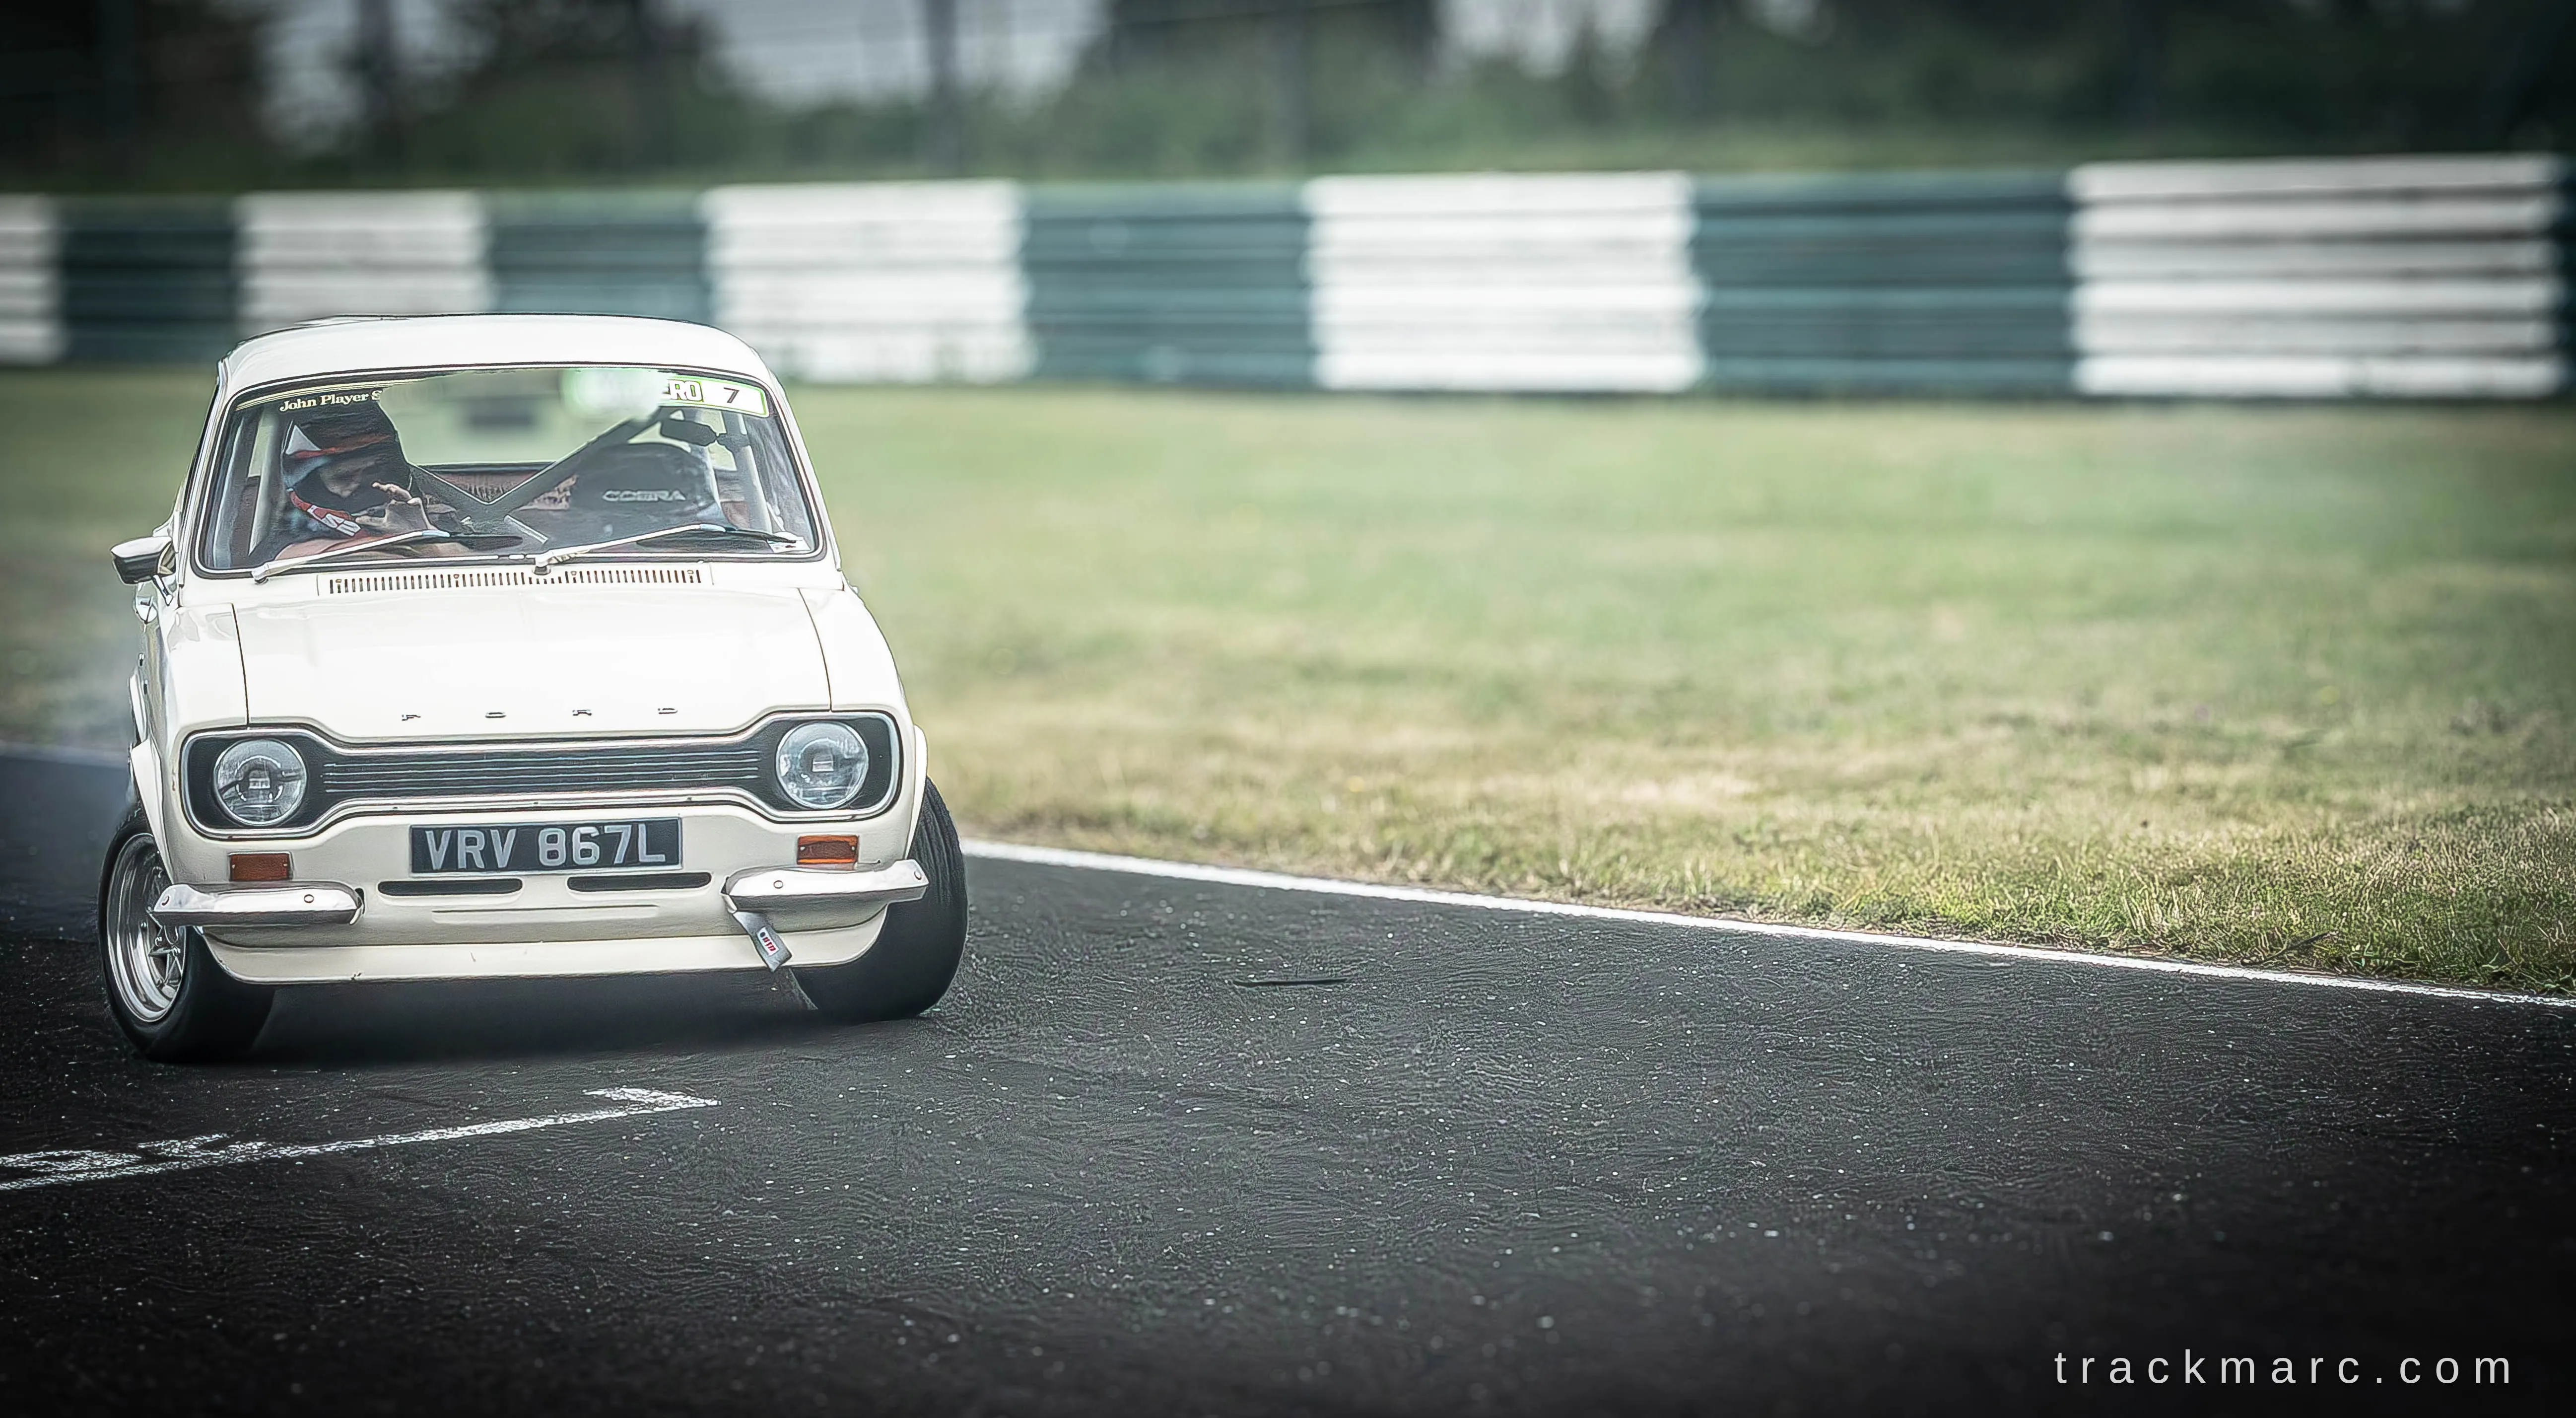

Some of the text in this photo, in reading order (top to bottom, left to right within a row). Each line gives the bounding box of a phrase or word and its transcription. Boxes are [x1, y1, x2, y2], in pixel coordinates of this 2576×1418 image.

[279, 399, 317, 412] John
[320, 393, 369, 406] Player
[723, 387, 740, 404] 7
[602, 489, 687, 502] COBRA
[424, 823, 667, 870] VRV 867L
